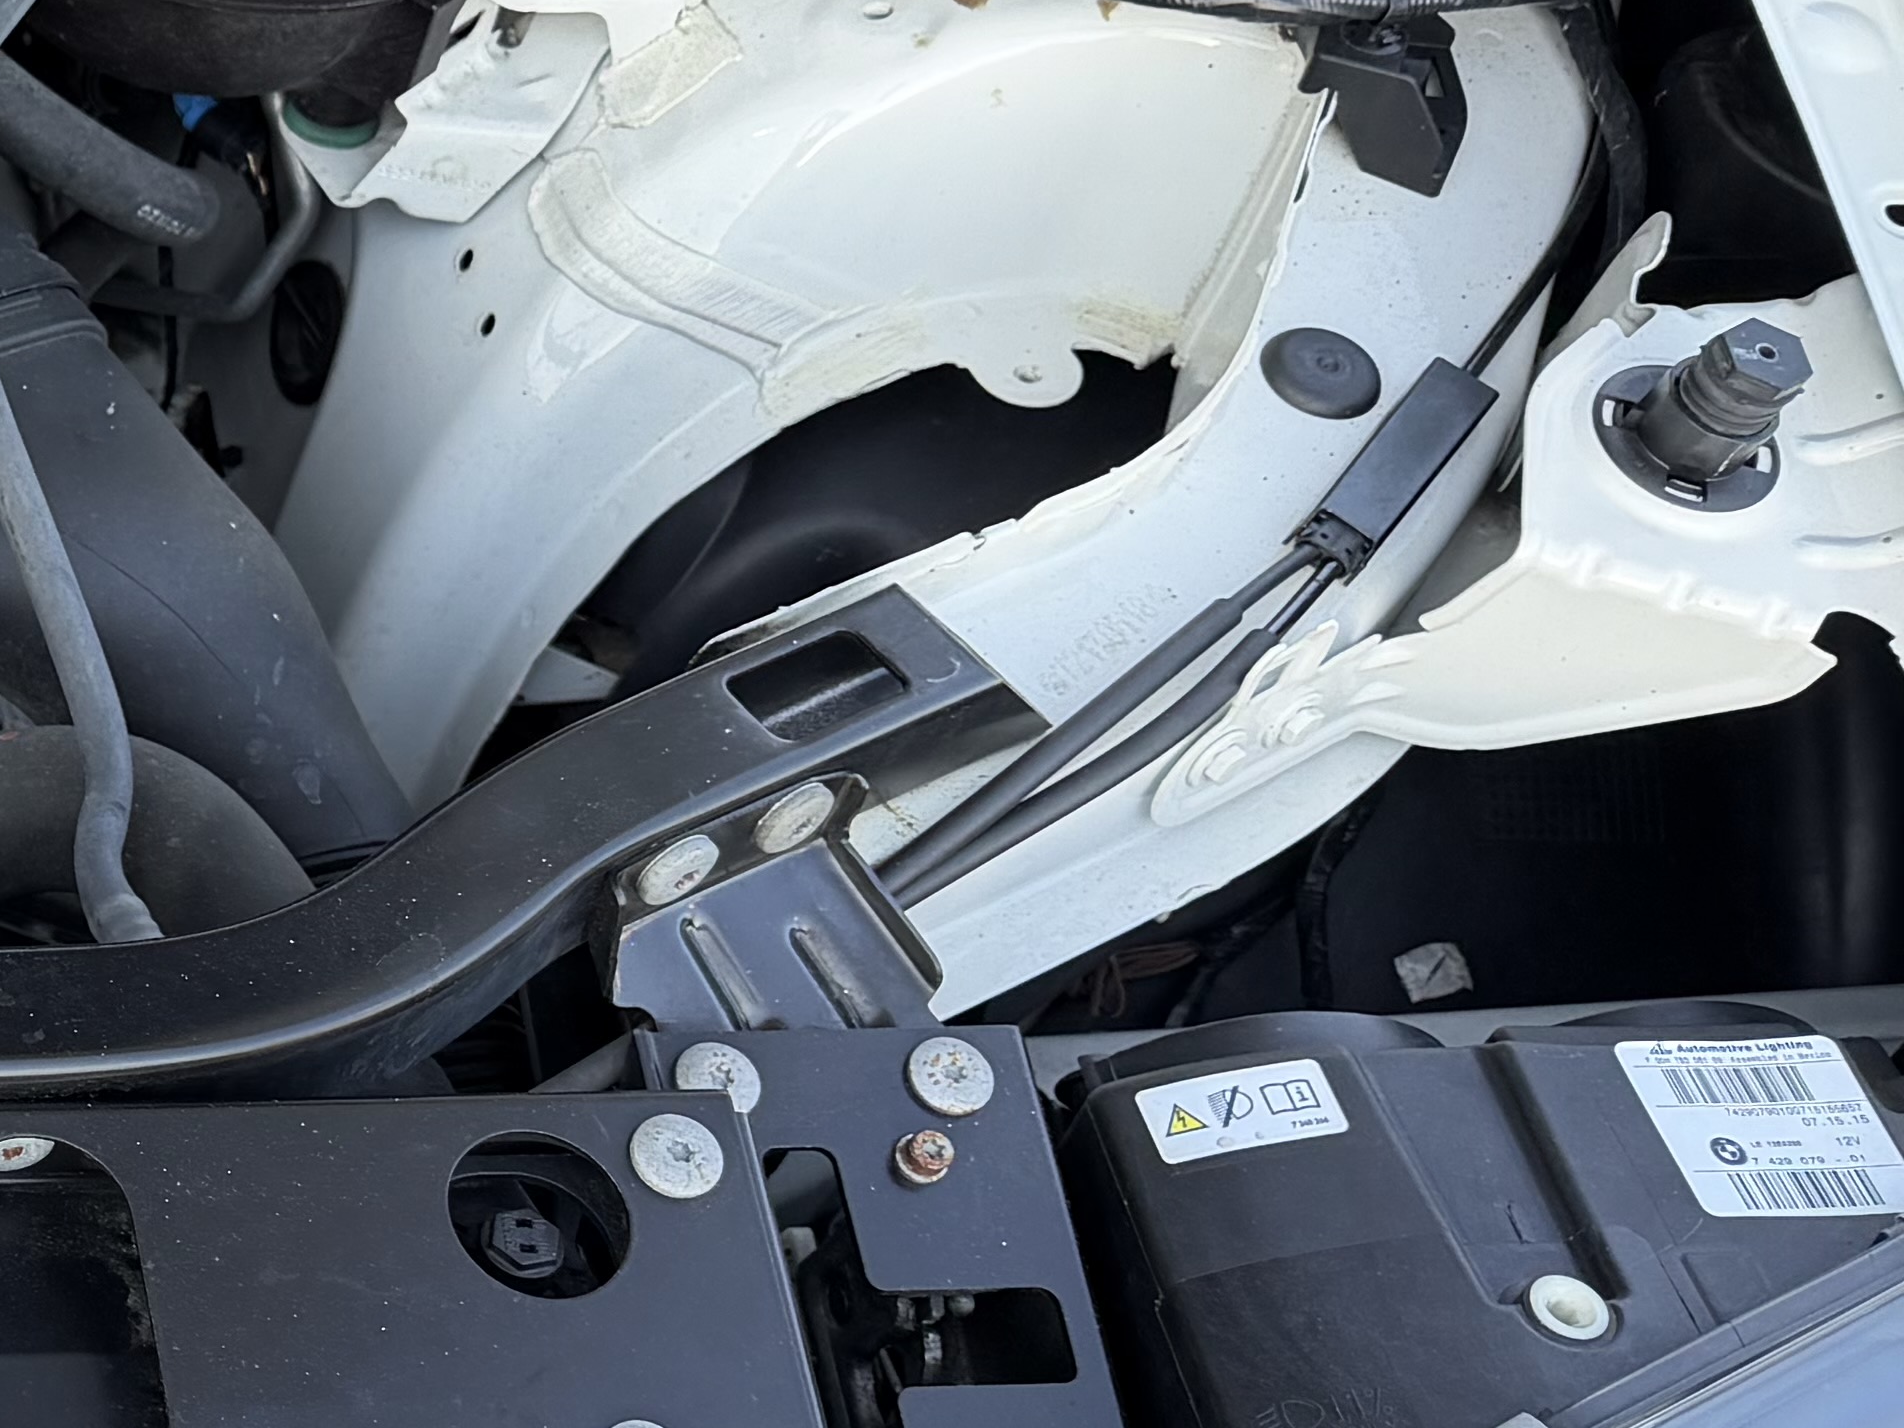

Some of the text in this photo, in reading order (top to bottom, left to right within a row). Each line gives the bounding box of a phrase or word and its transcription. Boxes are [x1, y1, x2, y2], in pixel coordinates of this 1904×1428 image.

[1677, 1040, 1814, 1055] Automotive Lighting
[1835, 1135, 1861, 1147] 12V
